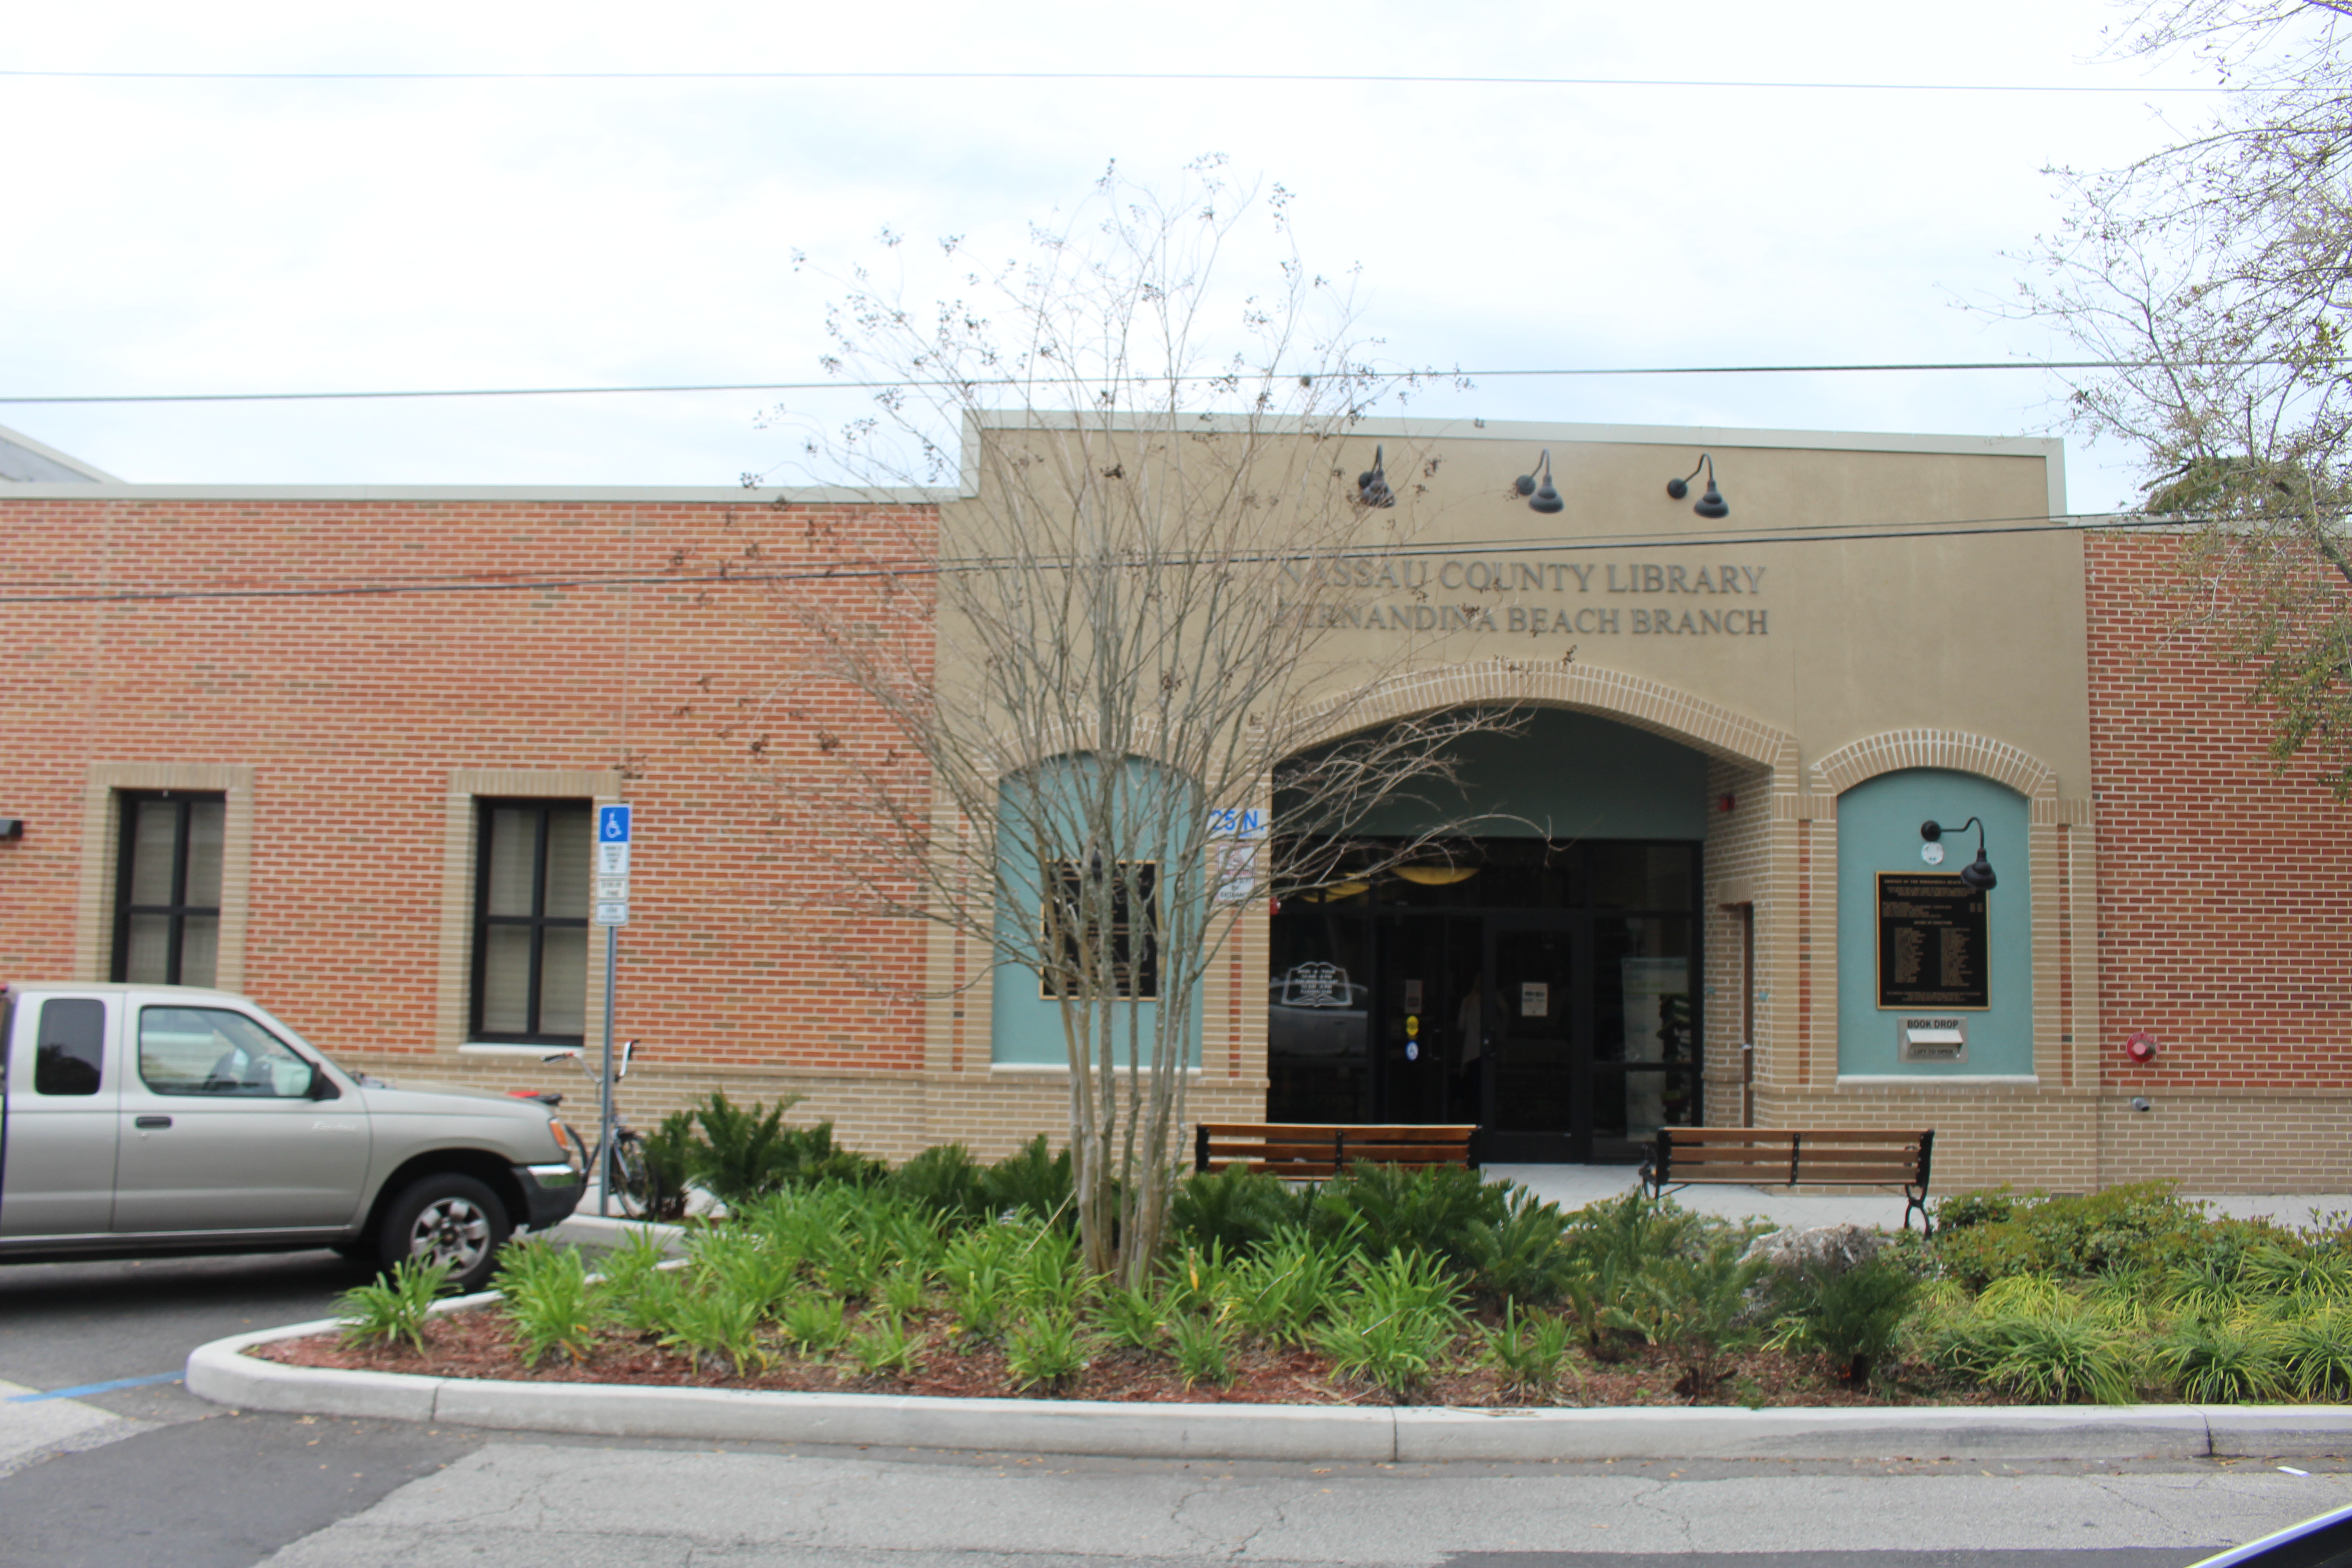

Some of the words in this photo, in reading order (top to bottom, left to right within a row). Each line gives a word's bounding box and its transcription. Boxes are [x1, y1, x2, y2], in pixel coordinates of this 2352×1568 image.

[1440, 561, 1595, 592] COUNTY
[1607, 563, 1766, 594] LIBRARY
[1508, 607, 1620, 634] BEACH
[1632, 609, 1768, 635] BRANCH
[1907, 1019, 1932, 1029] BOOK
[1934, 1019, 1959, 1029] DROP
